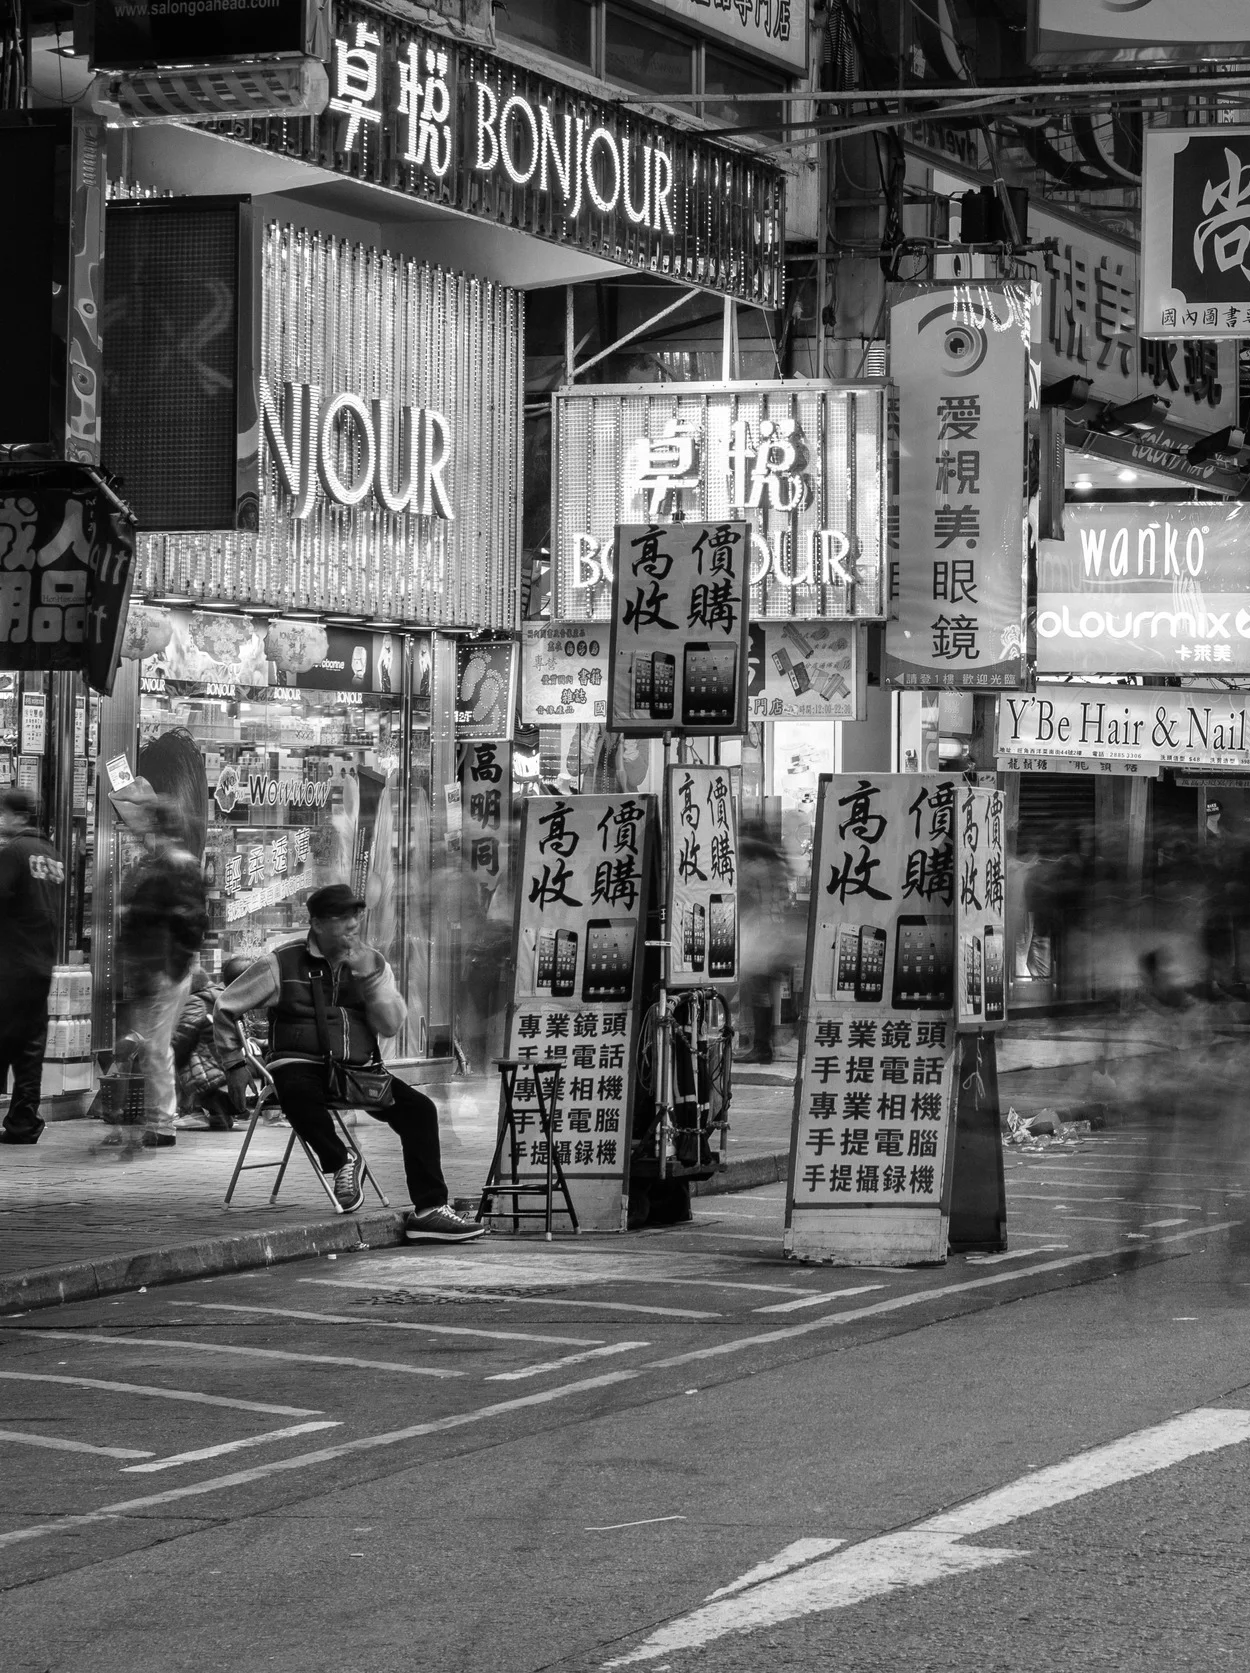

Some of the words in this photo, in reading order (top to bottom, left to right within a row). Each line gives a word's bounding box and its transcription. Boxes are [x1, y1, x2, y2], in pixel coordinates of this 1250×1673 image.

[475, 80, 674, 235] BONJOUR
[631, 525, 741, 580] 高價
[1080, 522, 1204, 577] wanko
[622, 578, 741, 635] 收購
[1176, 644, 1231, 661] 卡萊美
[206, 682, 236, 697] BONJOUR
[274, 686, 301, 701] BONJOUR
[336, 691, 363, 705] BONJOUR
[1079, 702, 1143, 746] Hair
[1152, 706, 1180, 747] &
[1186, 708, 1247, 752] Nail
[539, 800, 645, 857] 高價
[678, 772, 730, 831] 高價
[838, 780, 953, 845] 高價
[961, 787, 1003, 853] 高價
[528, 854, 641, 911] 收購
[679, 830, 735, 886] 收購
[826, 842, 953, 907] 收購
[961, 853, 1004, 917] 收購
[518, 1013, 627, 1040] 專業鏡頭
[814, 1019, 948, 1049] 專業鏡頭
[811, 1055, 945, 1086] 手提電話
[808, 1091, 942, 1122] 專業相機
[805, 1127, 939, 1159] 手提電腦
